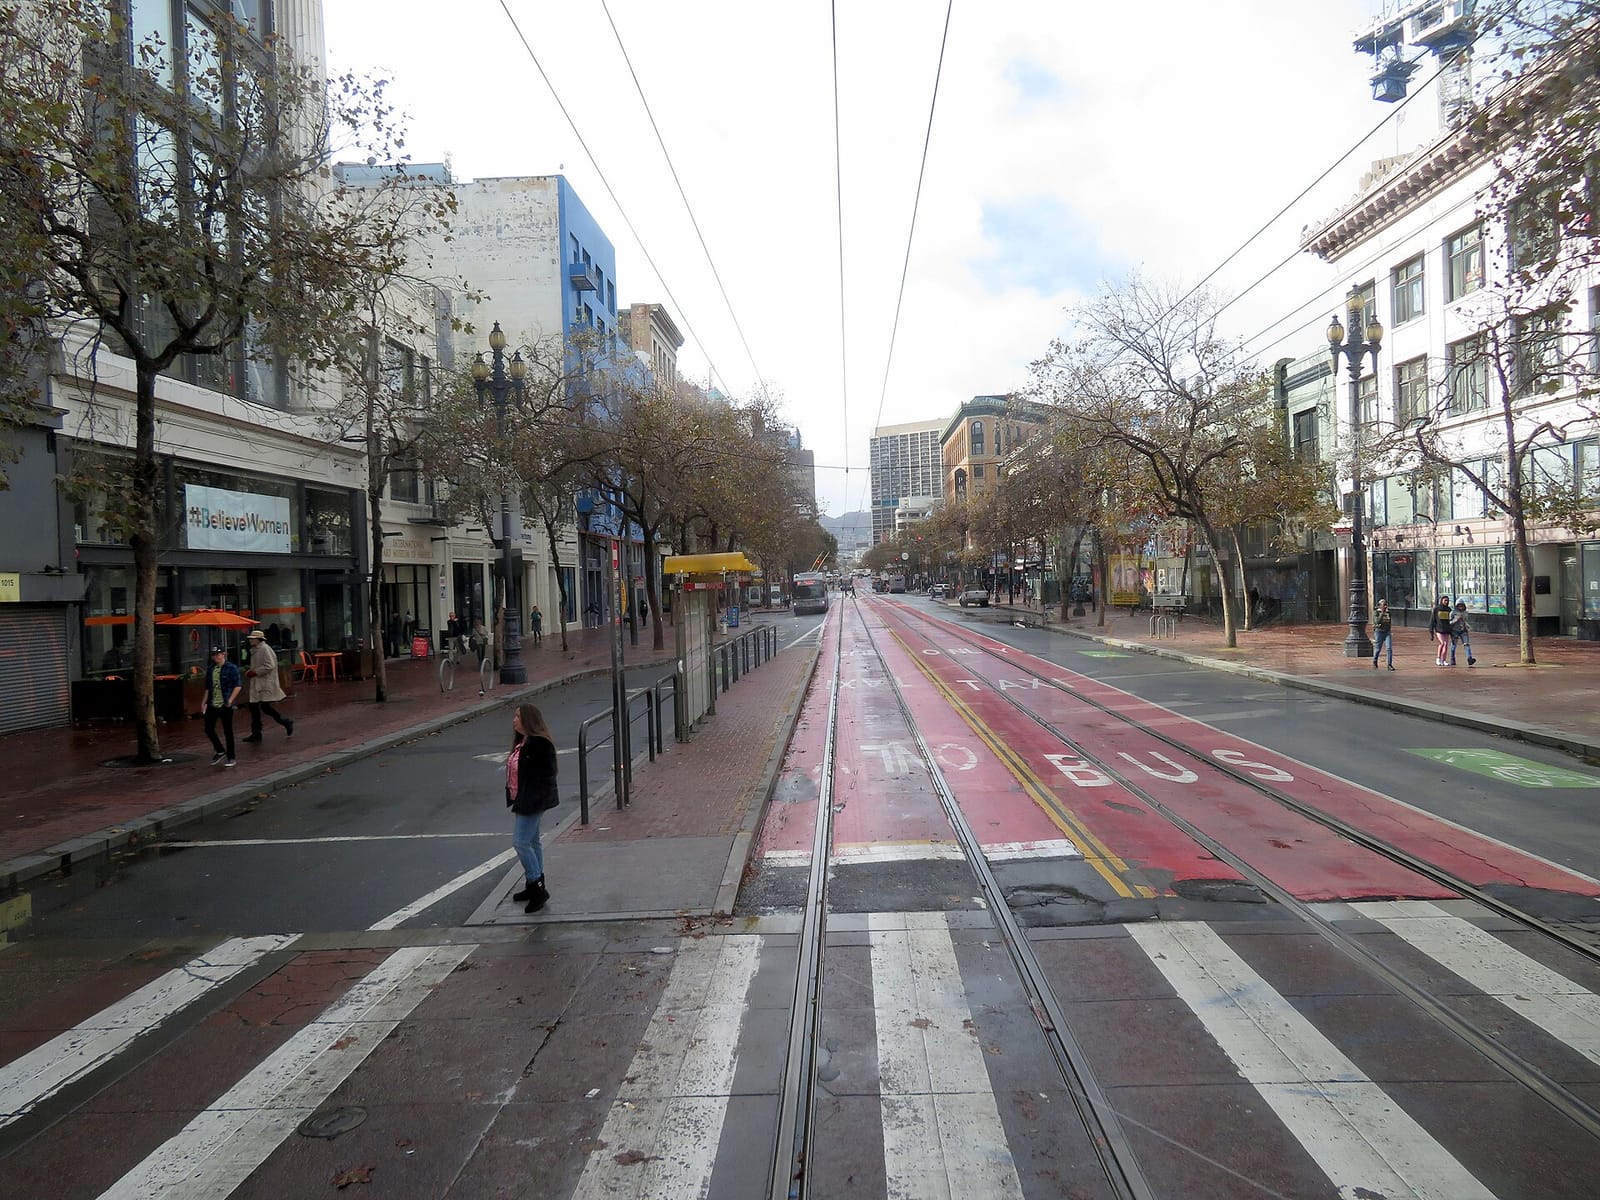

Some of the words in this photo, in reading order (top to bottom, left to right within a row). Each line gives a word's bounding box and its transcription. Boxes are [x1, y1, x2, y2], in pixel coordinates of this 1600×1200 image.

[189, 506, 289, 535] #BelieveWomen
[922, 647, 1009, 656] ONLY
[956, 677, 1075, 691] TAXI
[1043, 749, 1295, 787] BUS
